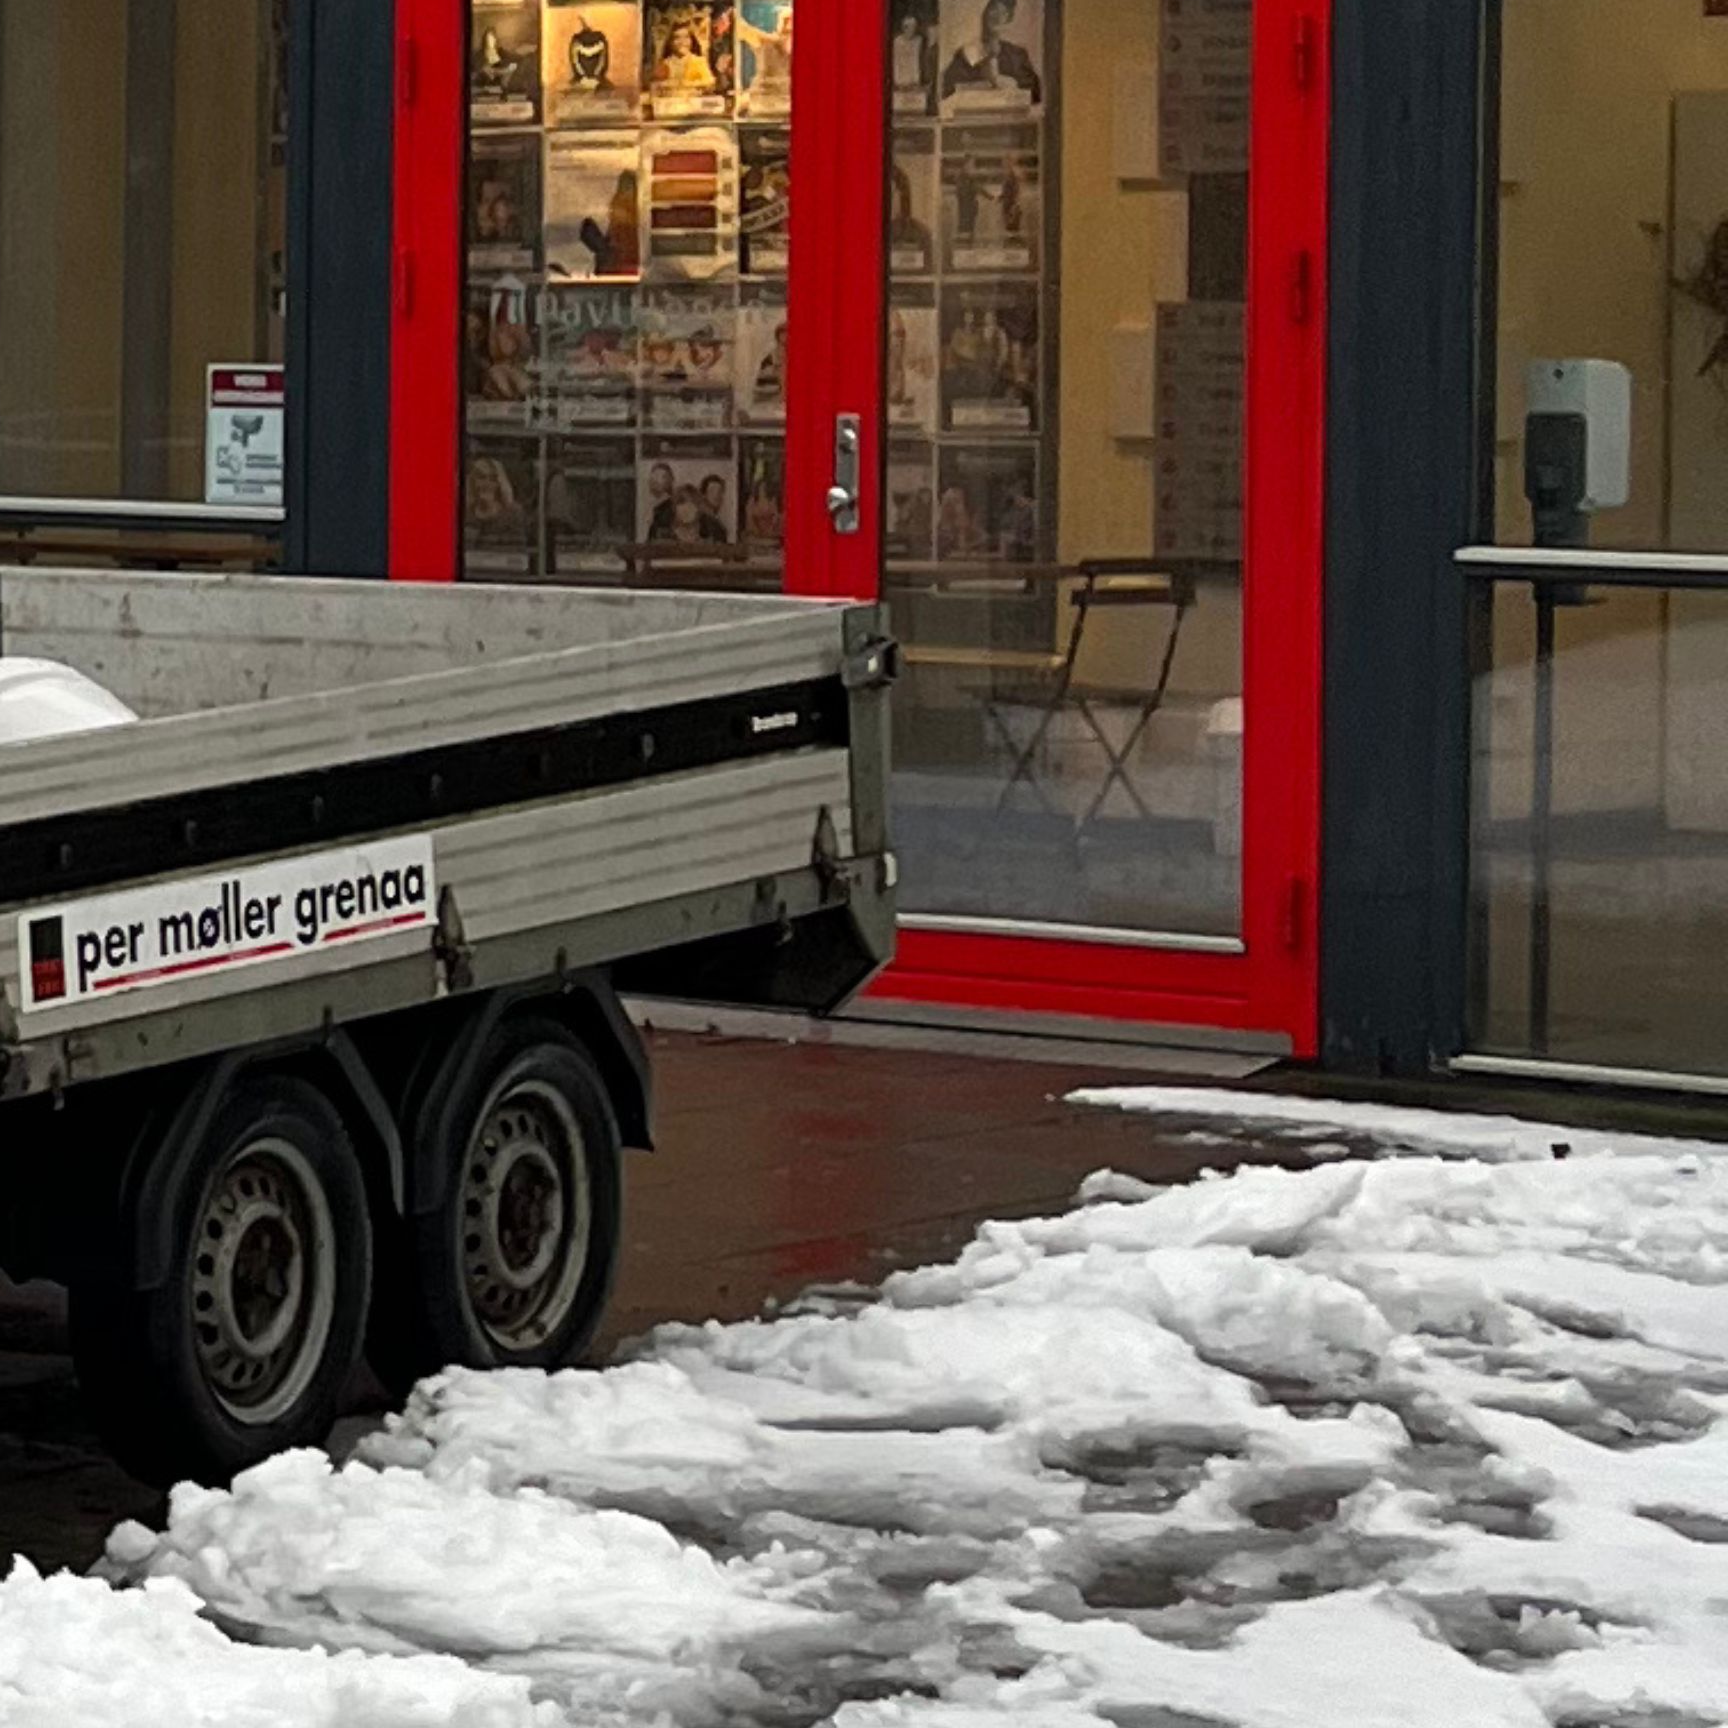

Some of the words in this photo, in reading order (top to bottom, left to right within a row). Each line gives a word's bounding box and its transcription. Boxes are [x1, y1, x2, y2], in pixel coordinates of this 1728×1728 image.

[76, 918, 145, 993] per
[158, 879, 284, 957] møller
[294, 864, 427, 946] grenaa
